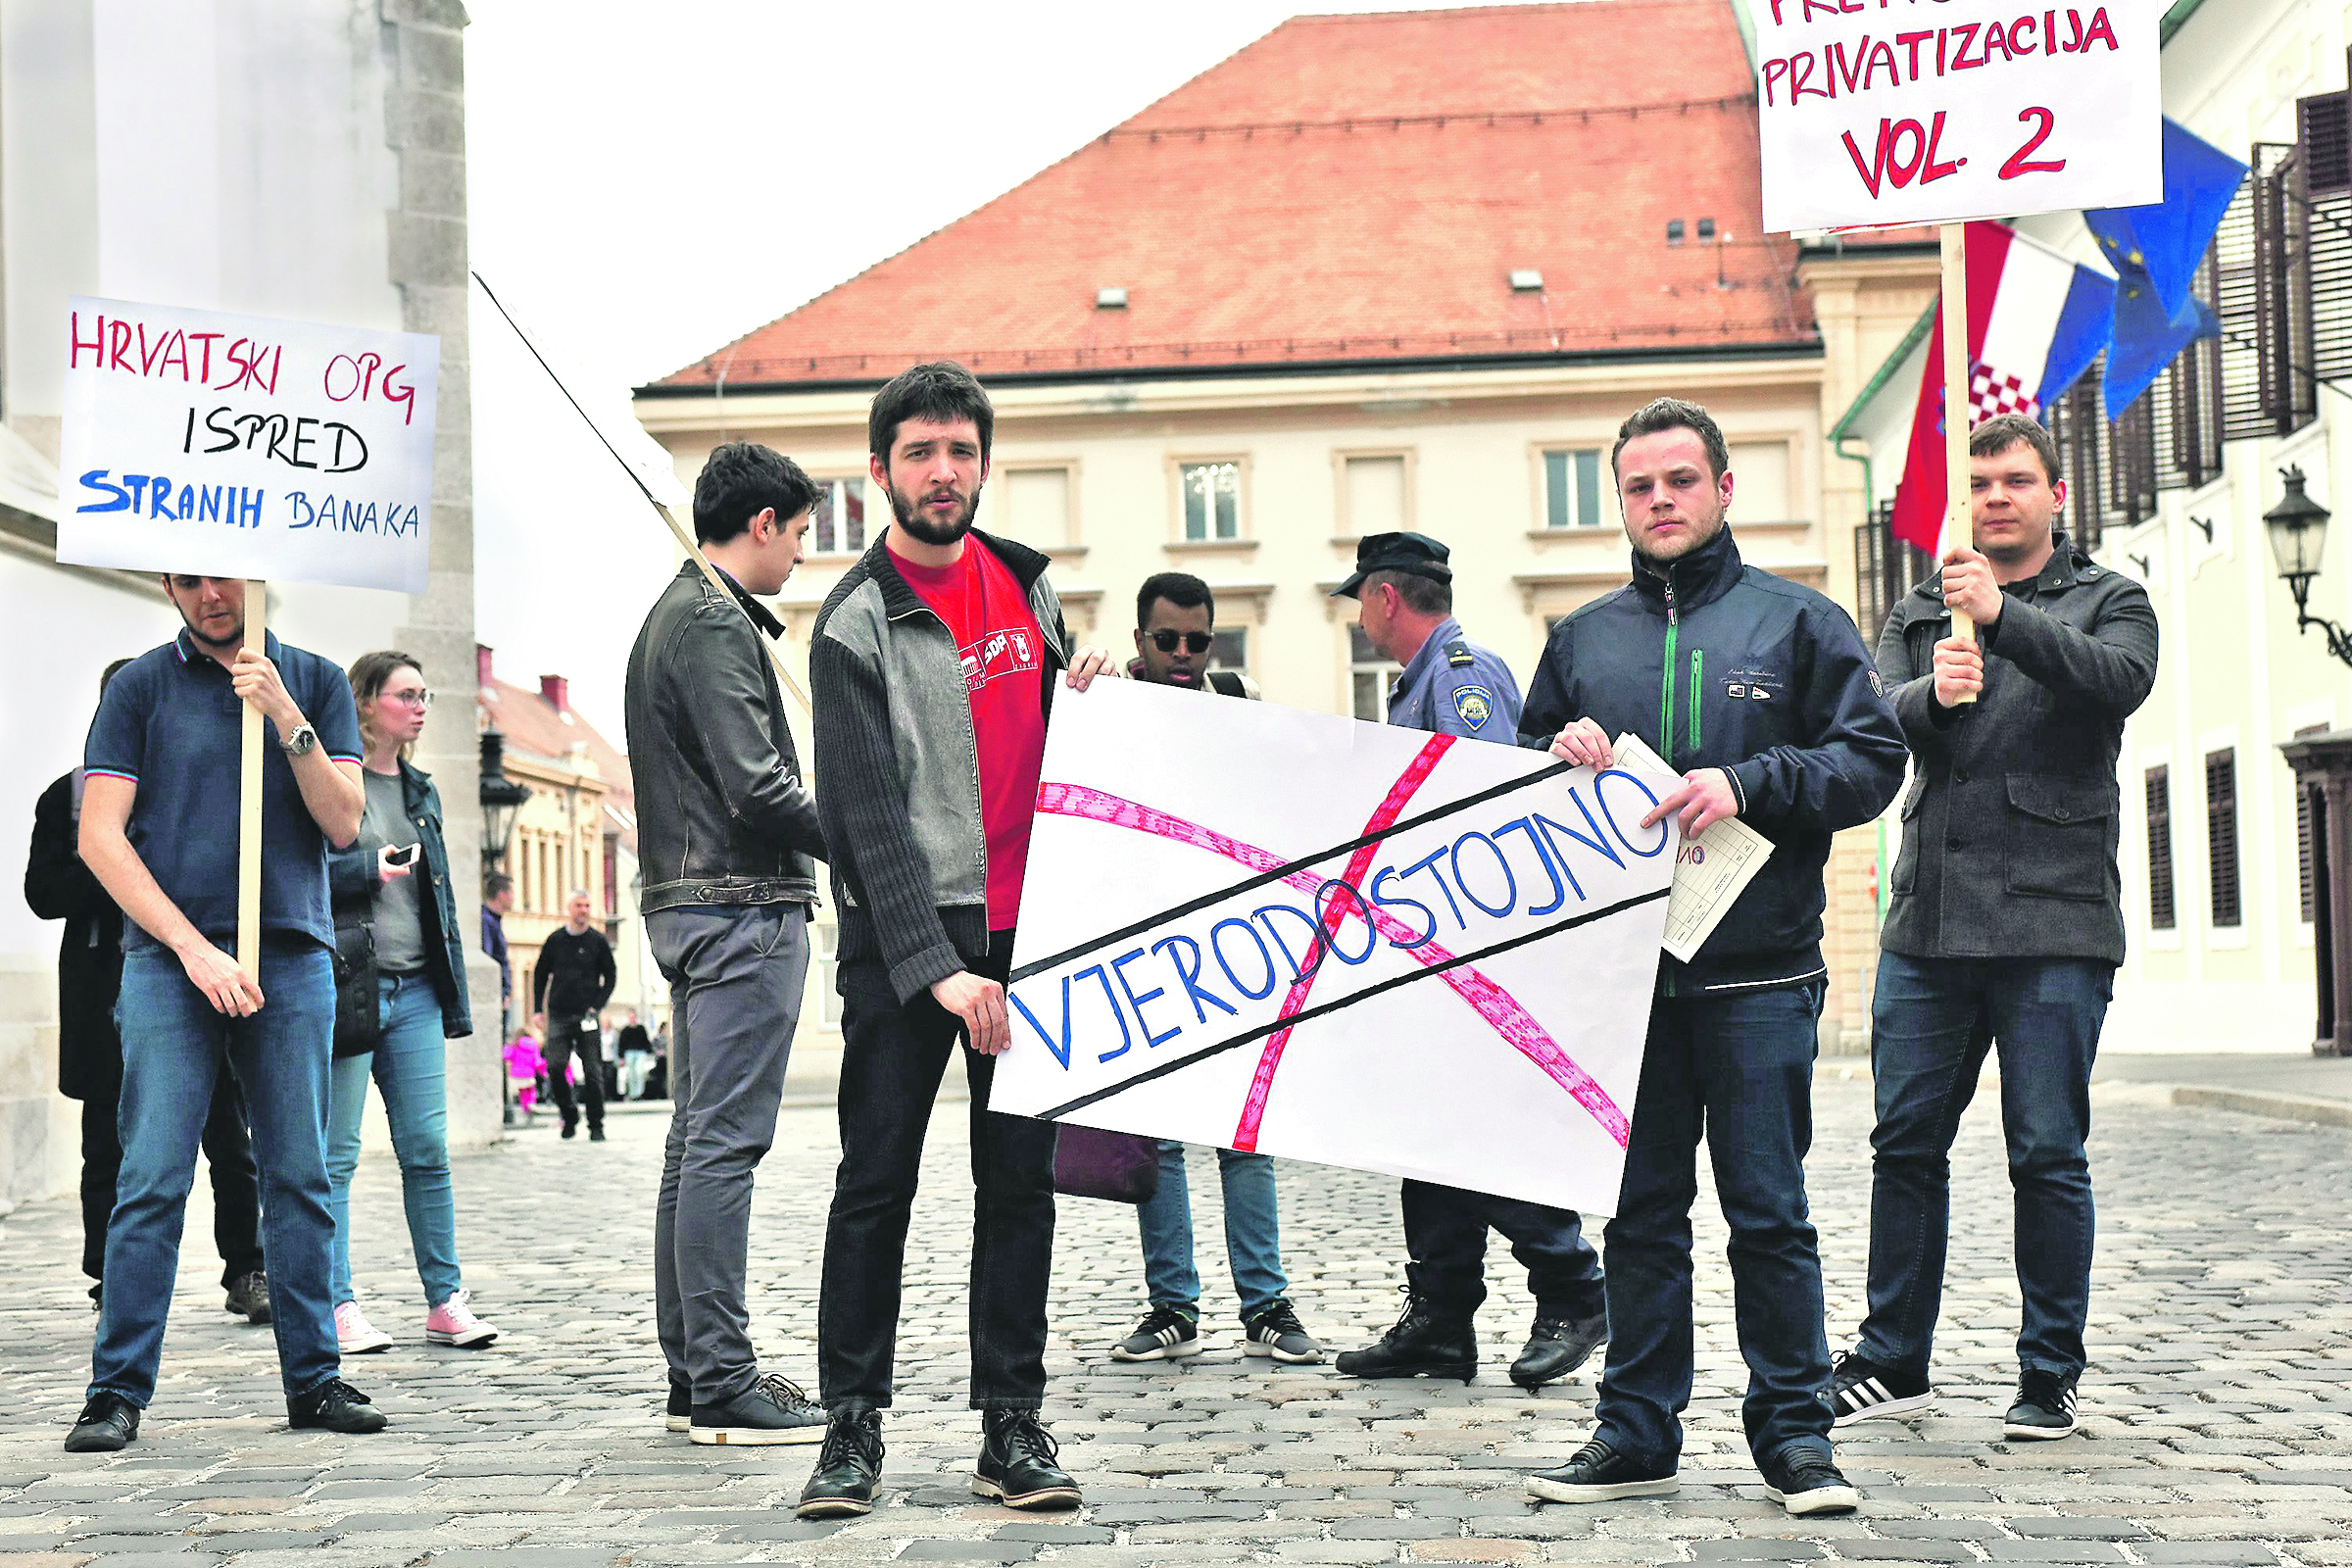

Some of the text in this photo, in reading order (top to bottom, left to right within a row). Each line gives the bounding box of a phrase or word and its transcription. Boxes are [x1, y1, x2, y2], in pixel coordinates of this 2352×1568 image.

[1762, 7, 2119, 107] PRIVATIZACIJA
[1840, 106, 2067, 200] VOL. 2
[71, 311, 416, 425] HRVATSKI OPG
[183, 407, 368, 473] ISPRED
[75, 468, 419, 539] STRANIH BANAKA
[984, 634, 1007, 665] SDP
[1010, 769, 1669, 1071] VJERODOSTOJNO
